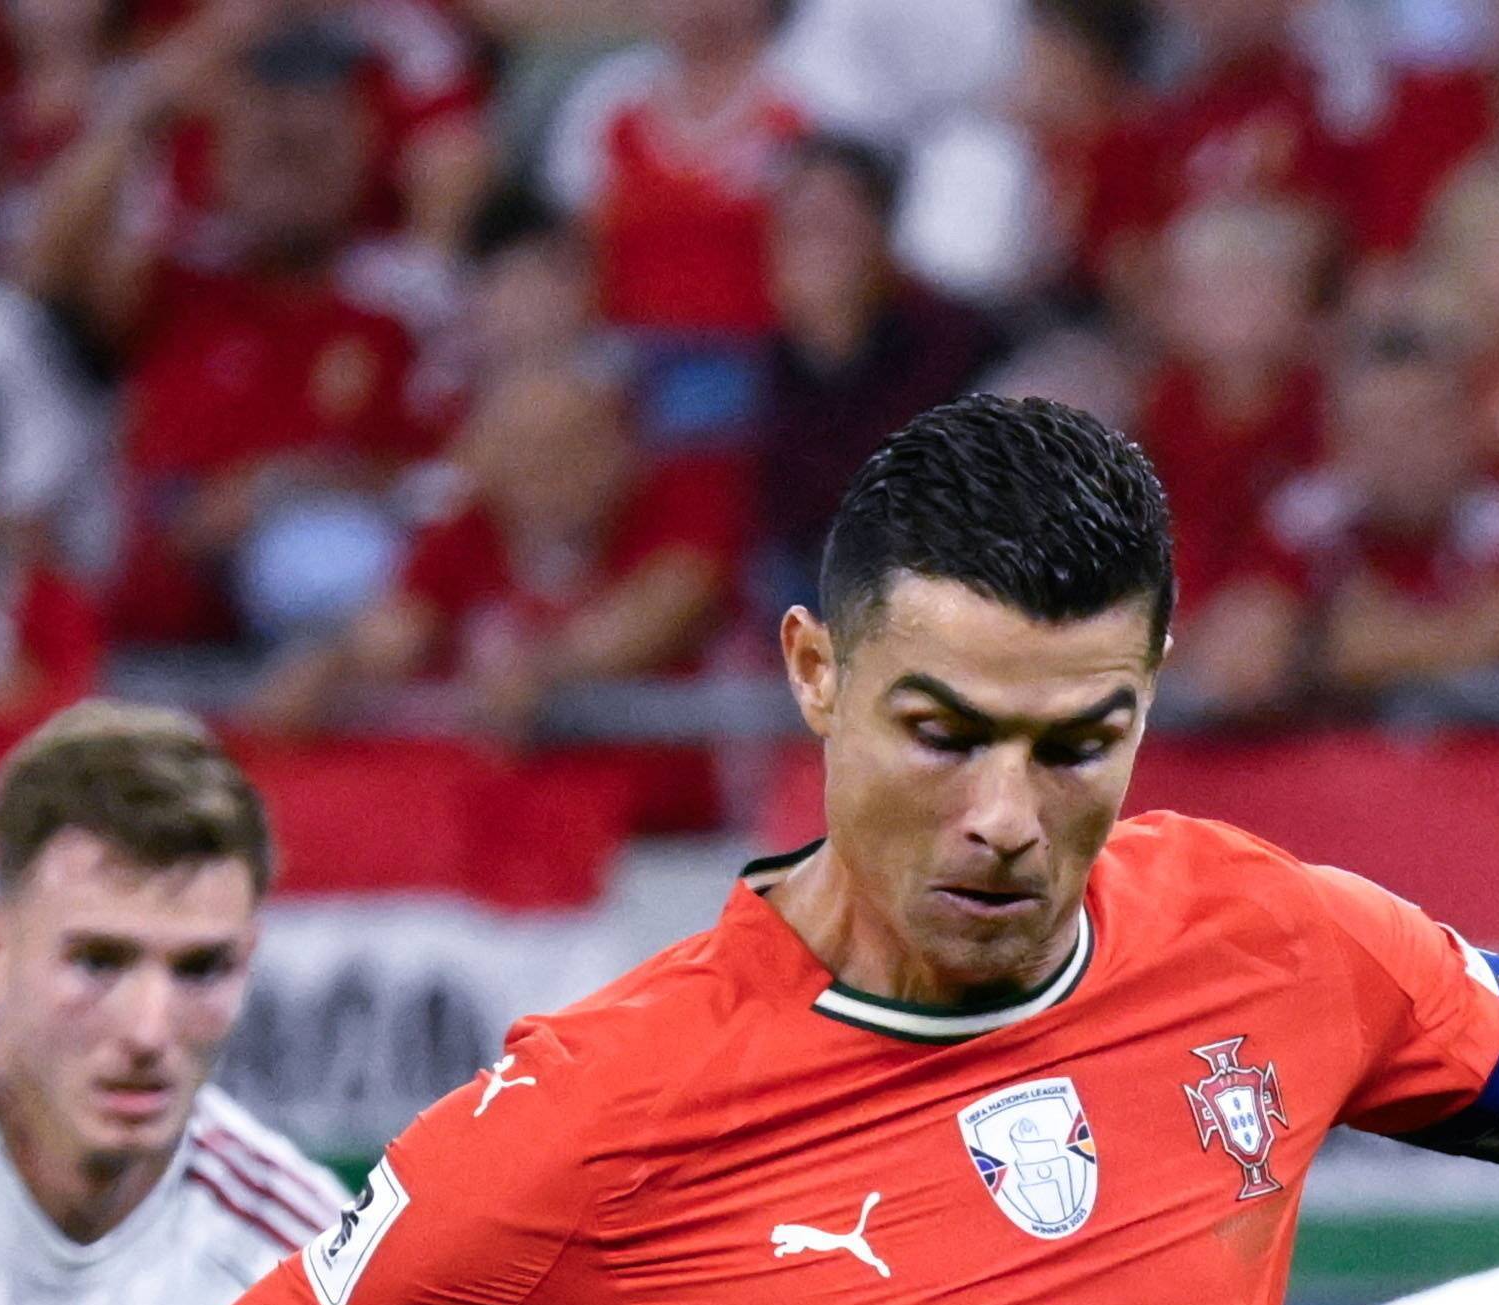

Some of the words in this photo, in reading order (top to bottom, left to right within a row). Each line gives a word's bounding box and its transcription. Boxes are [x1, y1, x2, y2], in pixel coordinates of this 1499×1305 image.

[965, 1110, 988, 1125] UEFA
[988, 1091, 1030, 1112] NATIONS
[1030, 1085, 1068, 1099] LEAGUE
[1031, 1222, 1069, 1234] WINNER
